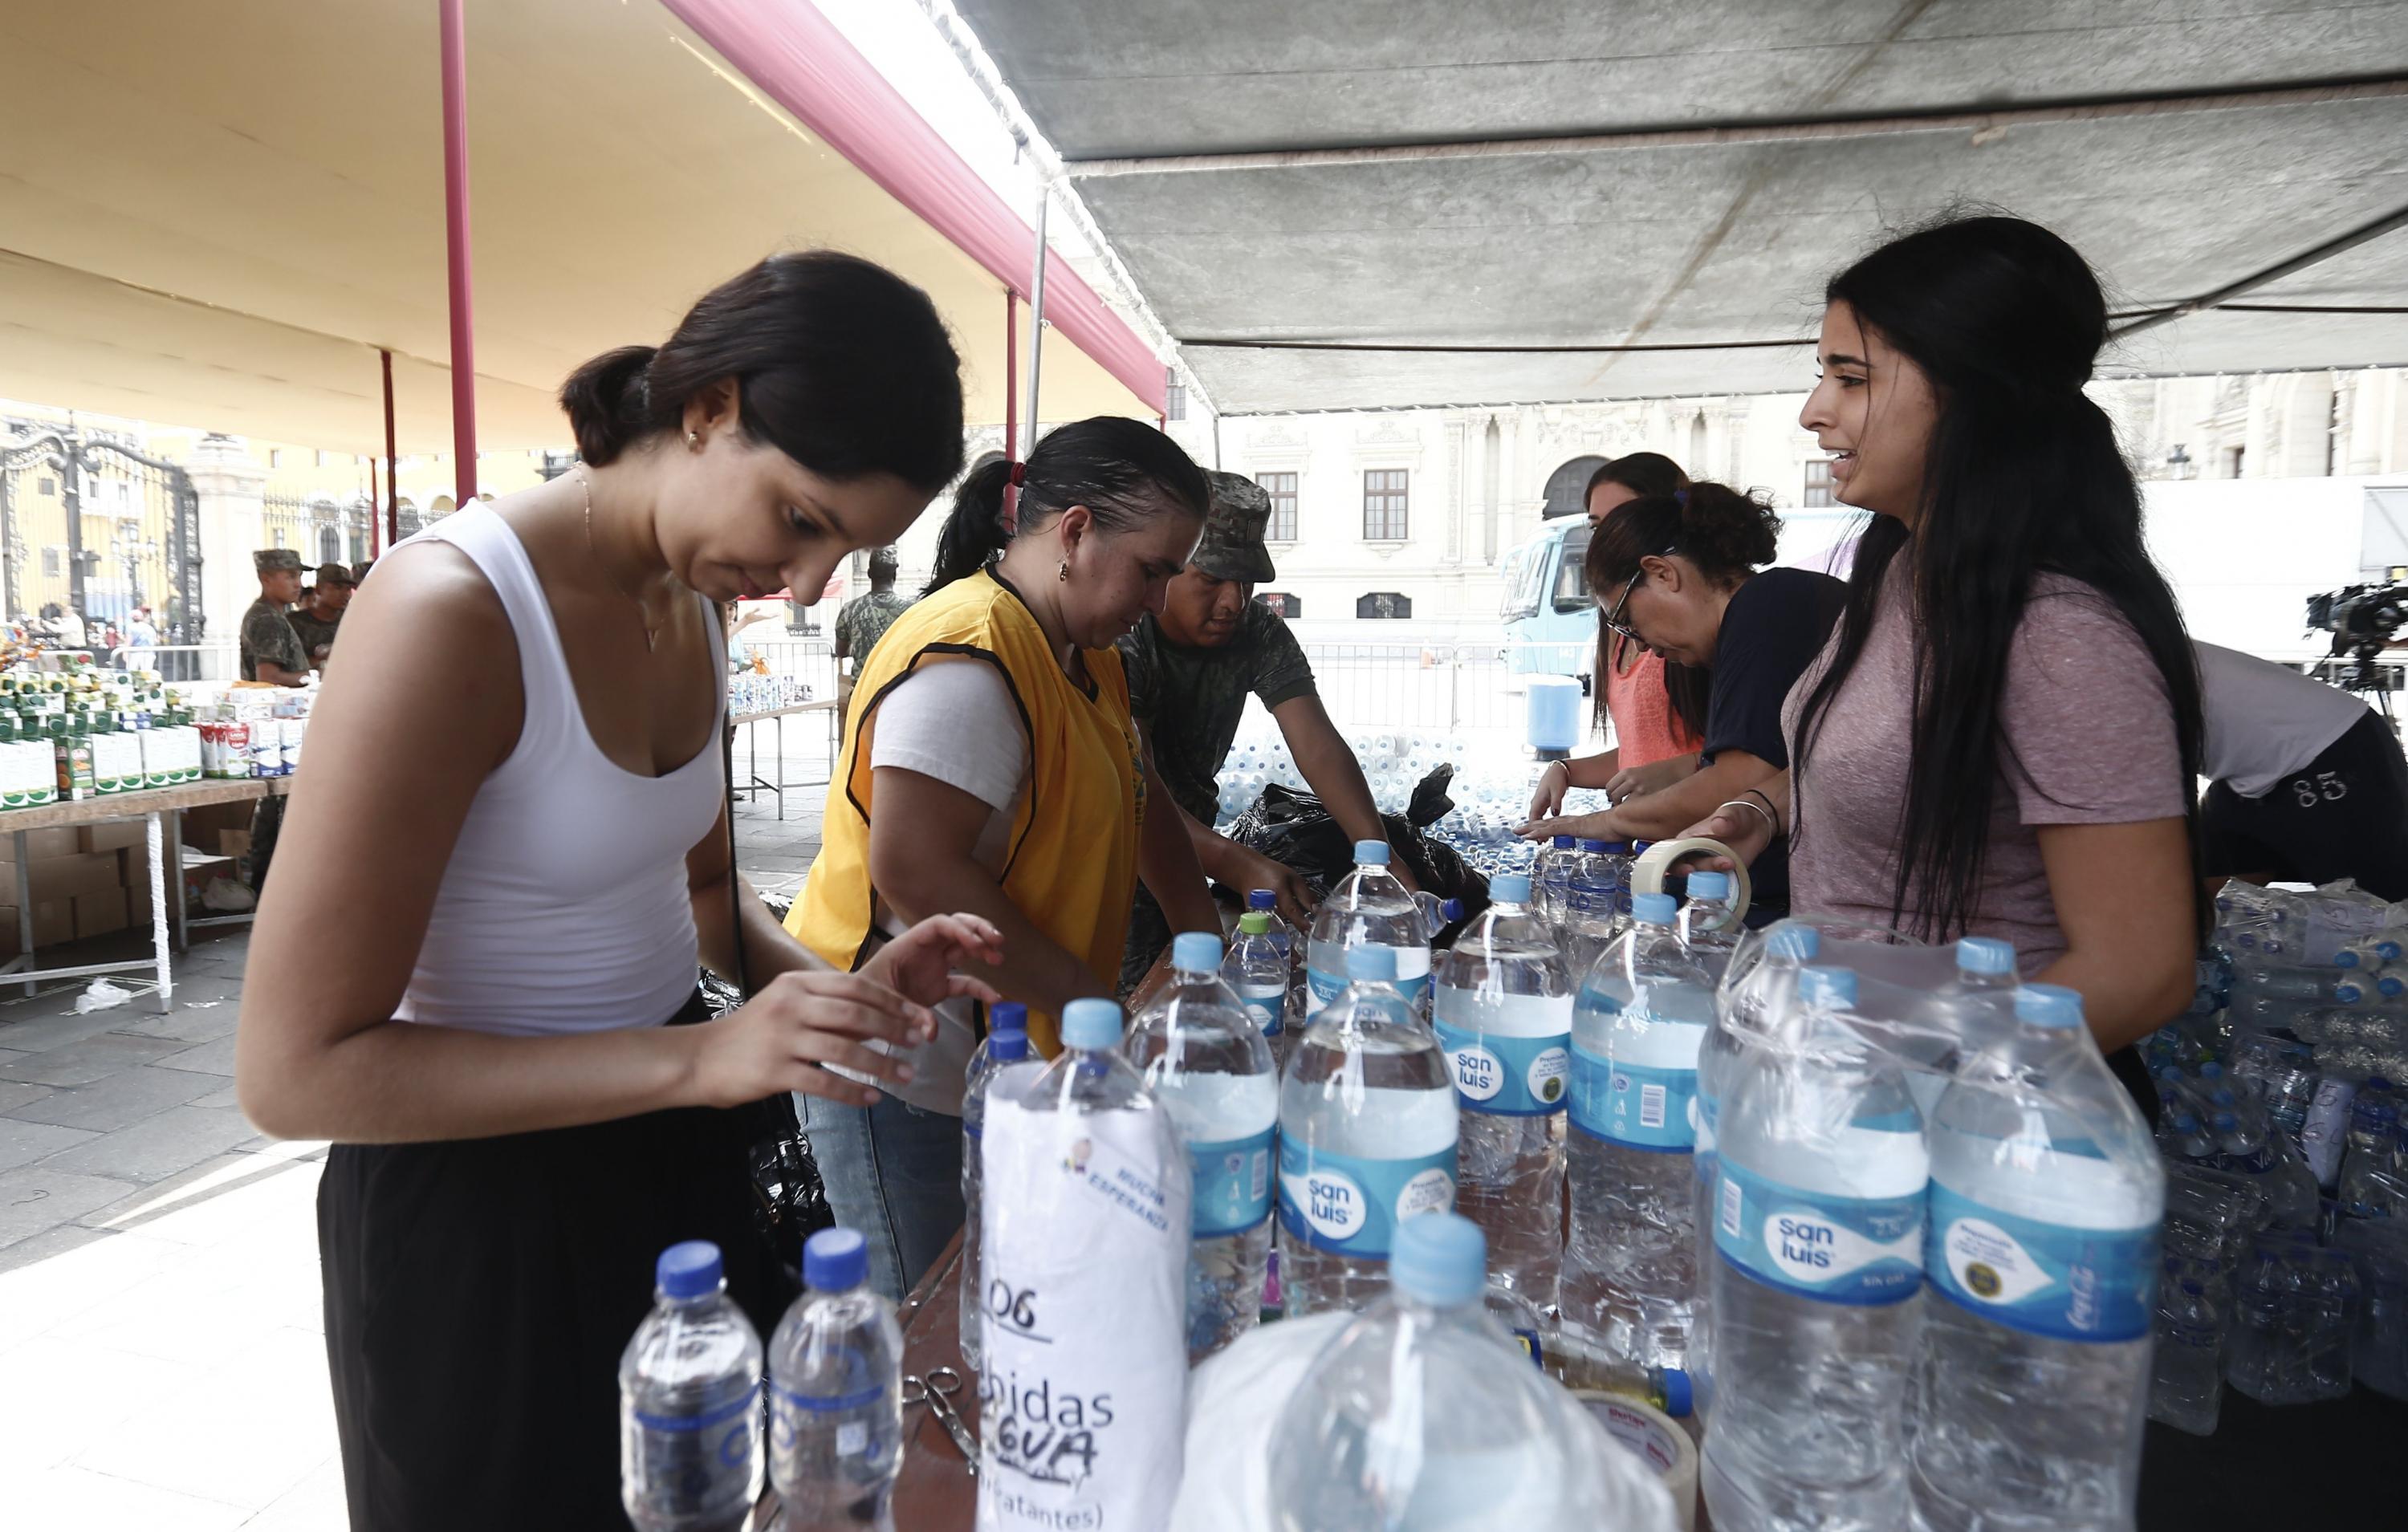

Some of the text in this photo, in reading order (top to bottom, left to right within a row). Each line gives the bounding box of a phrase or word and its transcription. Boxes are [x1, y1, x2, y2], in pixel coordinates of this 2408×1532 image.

[2293, 770, 2348, 807] 85
[1458, 1053, 1492, 1073] san
[1459, 1068, 1491, 1089] luis
[1308, 1178, 1350, 1204] san
[1311, 1196, 1348, 1225] luis
[1779, 1218, 1834, 1245] san
[1782, 1238, 1831, 1268] luis
